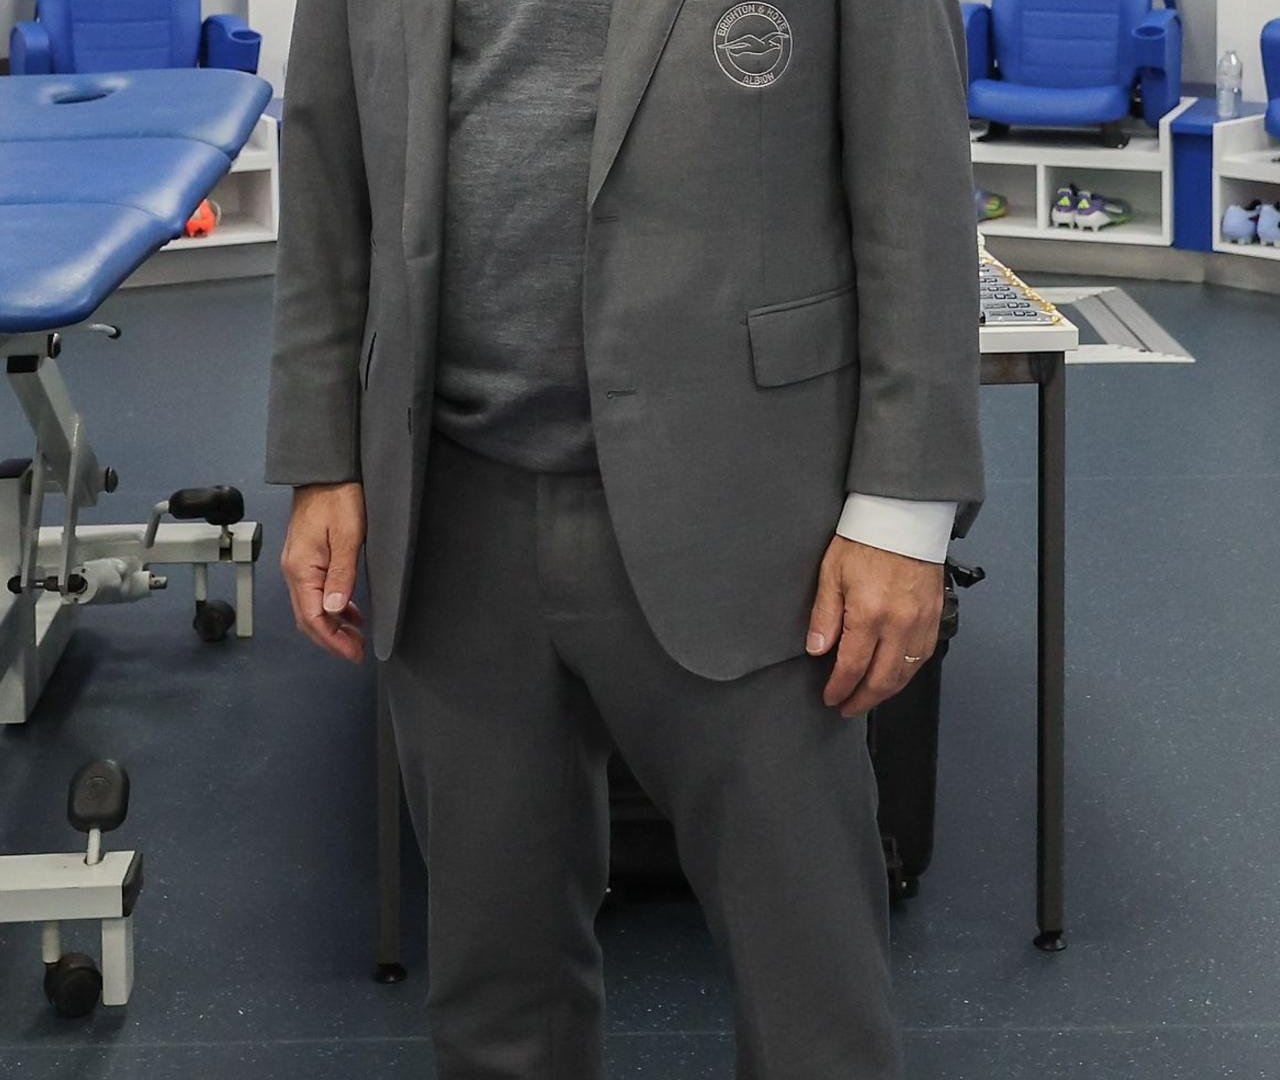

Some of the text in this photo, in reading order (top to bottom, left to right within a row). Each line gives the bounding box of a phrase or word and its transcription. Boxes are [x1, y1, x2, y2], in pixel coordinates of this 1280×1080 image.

[717, 4, 756, 37] BRIGHTON
[767, 8, 789, 32] HOVE
[742, 72, 775, 85] ALBION
